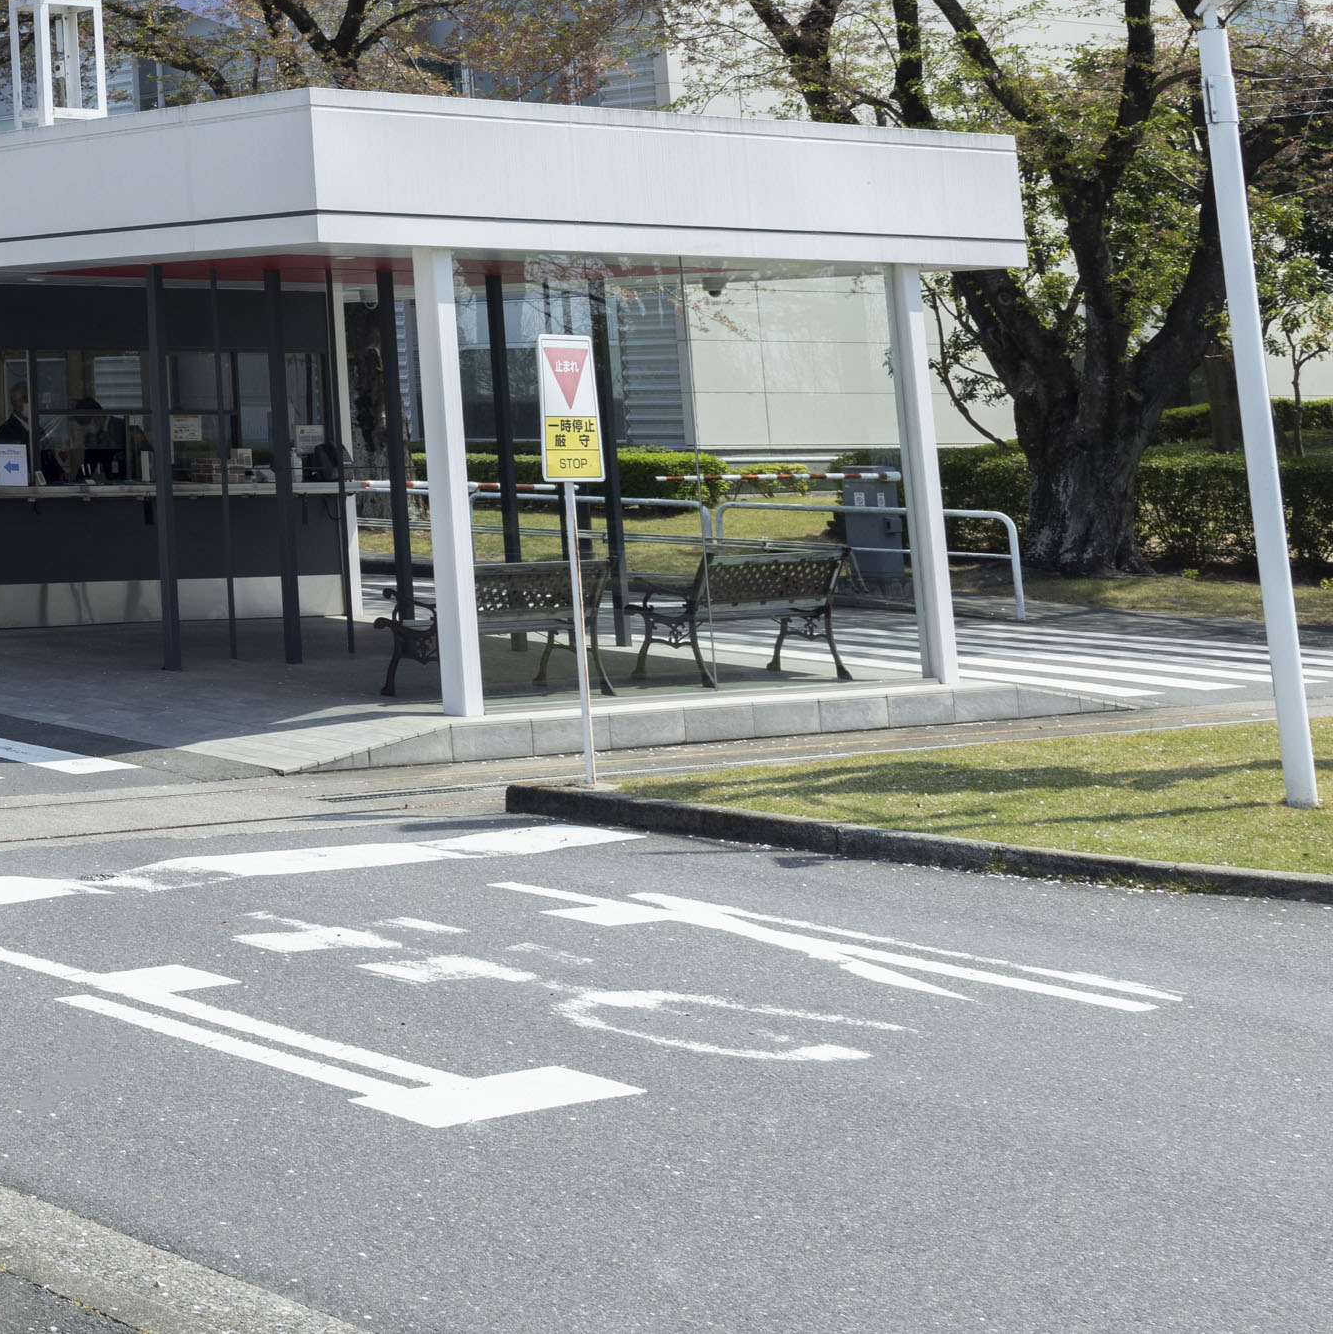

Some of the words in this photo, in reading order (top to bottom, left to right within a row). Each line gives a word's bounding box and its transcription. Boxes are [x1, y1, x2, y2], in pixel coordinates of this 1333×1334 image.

[555, 359, 580, 373] 止まれ
[548, 419, 595, 433] 一時停止
[559, 457, 589, 470] STOP
